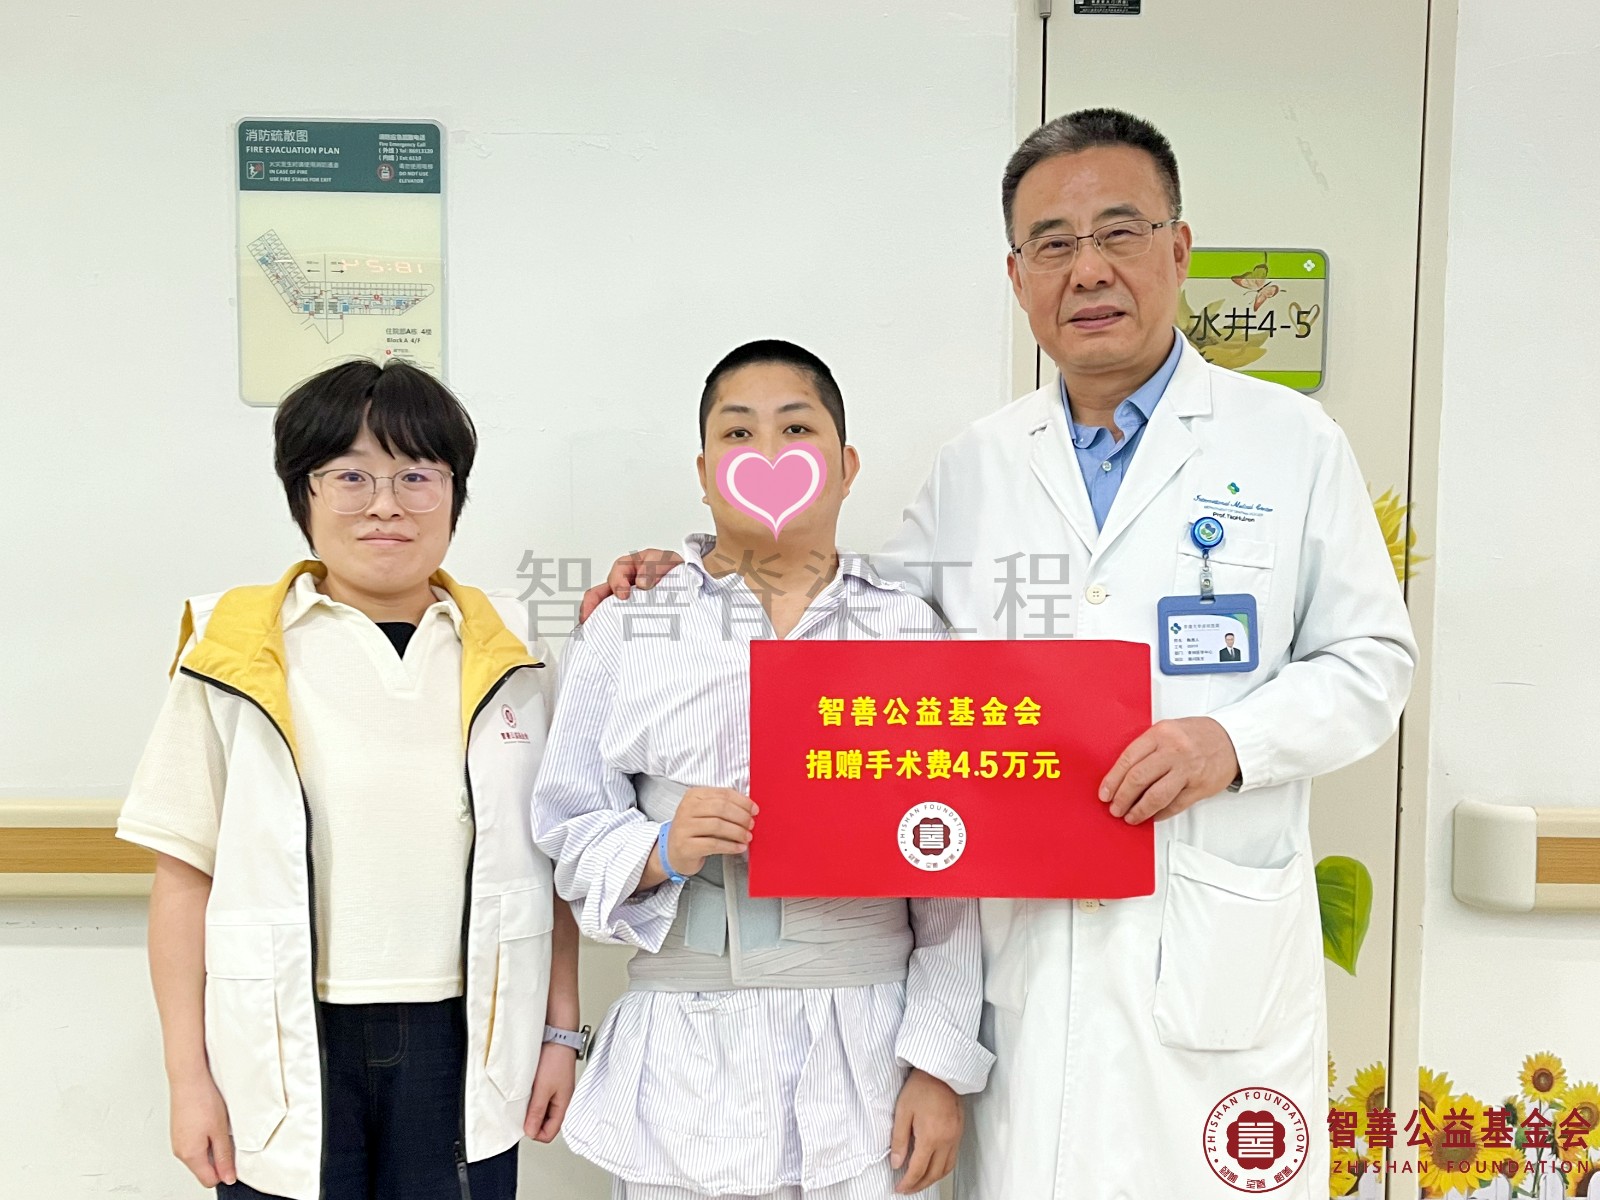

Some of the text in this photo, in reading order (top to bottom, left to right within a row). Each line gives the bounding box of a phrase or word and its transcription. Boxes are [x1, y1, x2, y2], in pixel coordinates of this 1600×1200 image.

[245, 129, 308, 142] 消防疏散图
[265, 146, 317, 154] EVACUATION
[1188, 306, 1312, 342] 水井4-5
[1193, 494, 1231, 507] International
[818, 696, 1042, 727] 智善公益基金会
[806, 749, 1061, 779] 捐赠手术费4.5万元
[900, 803, 964, 845] ZHISHAN FOUNDATION
